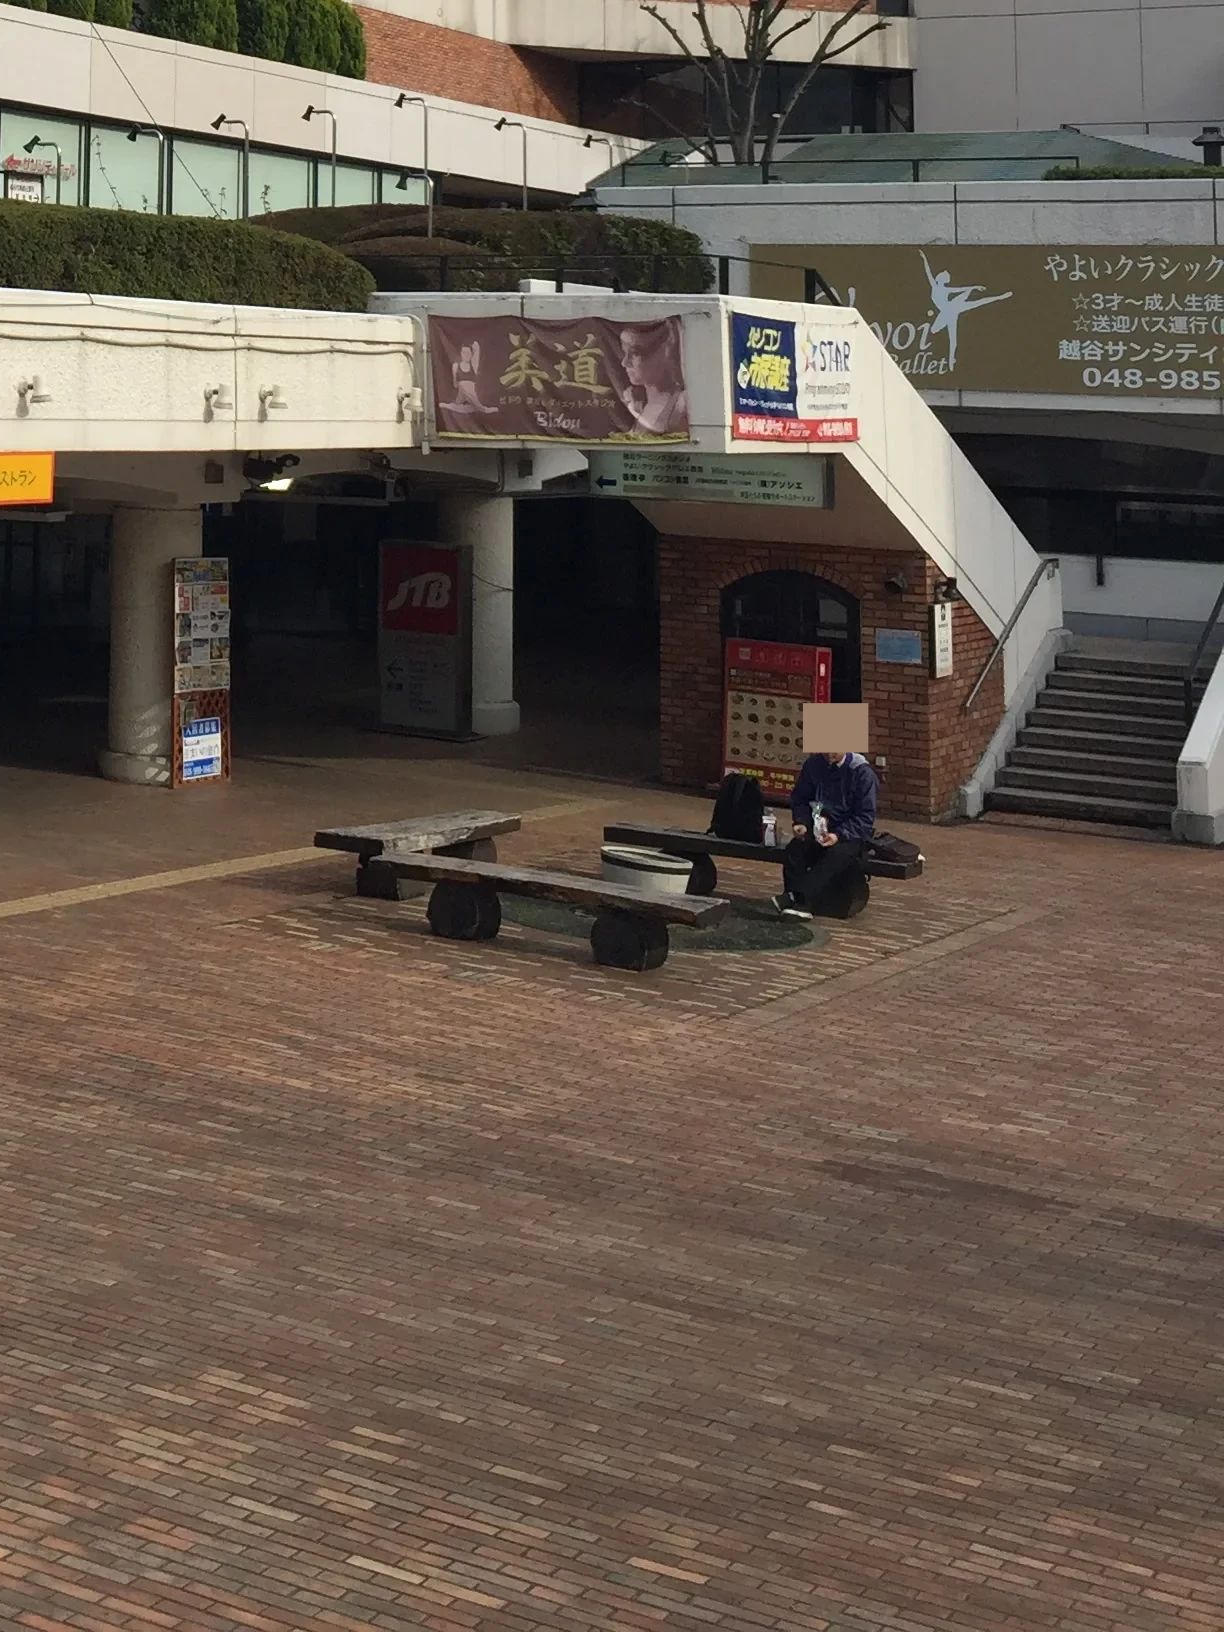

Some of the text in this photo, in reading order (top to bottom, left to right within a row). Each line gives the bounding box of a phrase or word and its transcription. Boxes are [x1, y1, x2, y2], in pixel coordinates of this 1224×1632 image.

[1044, 254, 1224, 282] やよいクラシック
[1091, 316, 1224, 334] 送迎バス運行(
[498, 333, 611, 394] 美道
[819, 341, 851, 372] STAR
[1058, 339, 1219, 364] 越谷サンシティ
[533, 411, 581, 429] Bidou
[386, 571, 452, 611] JTB
